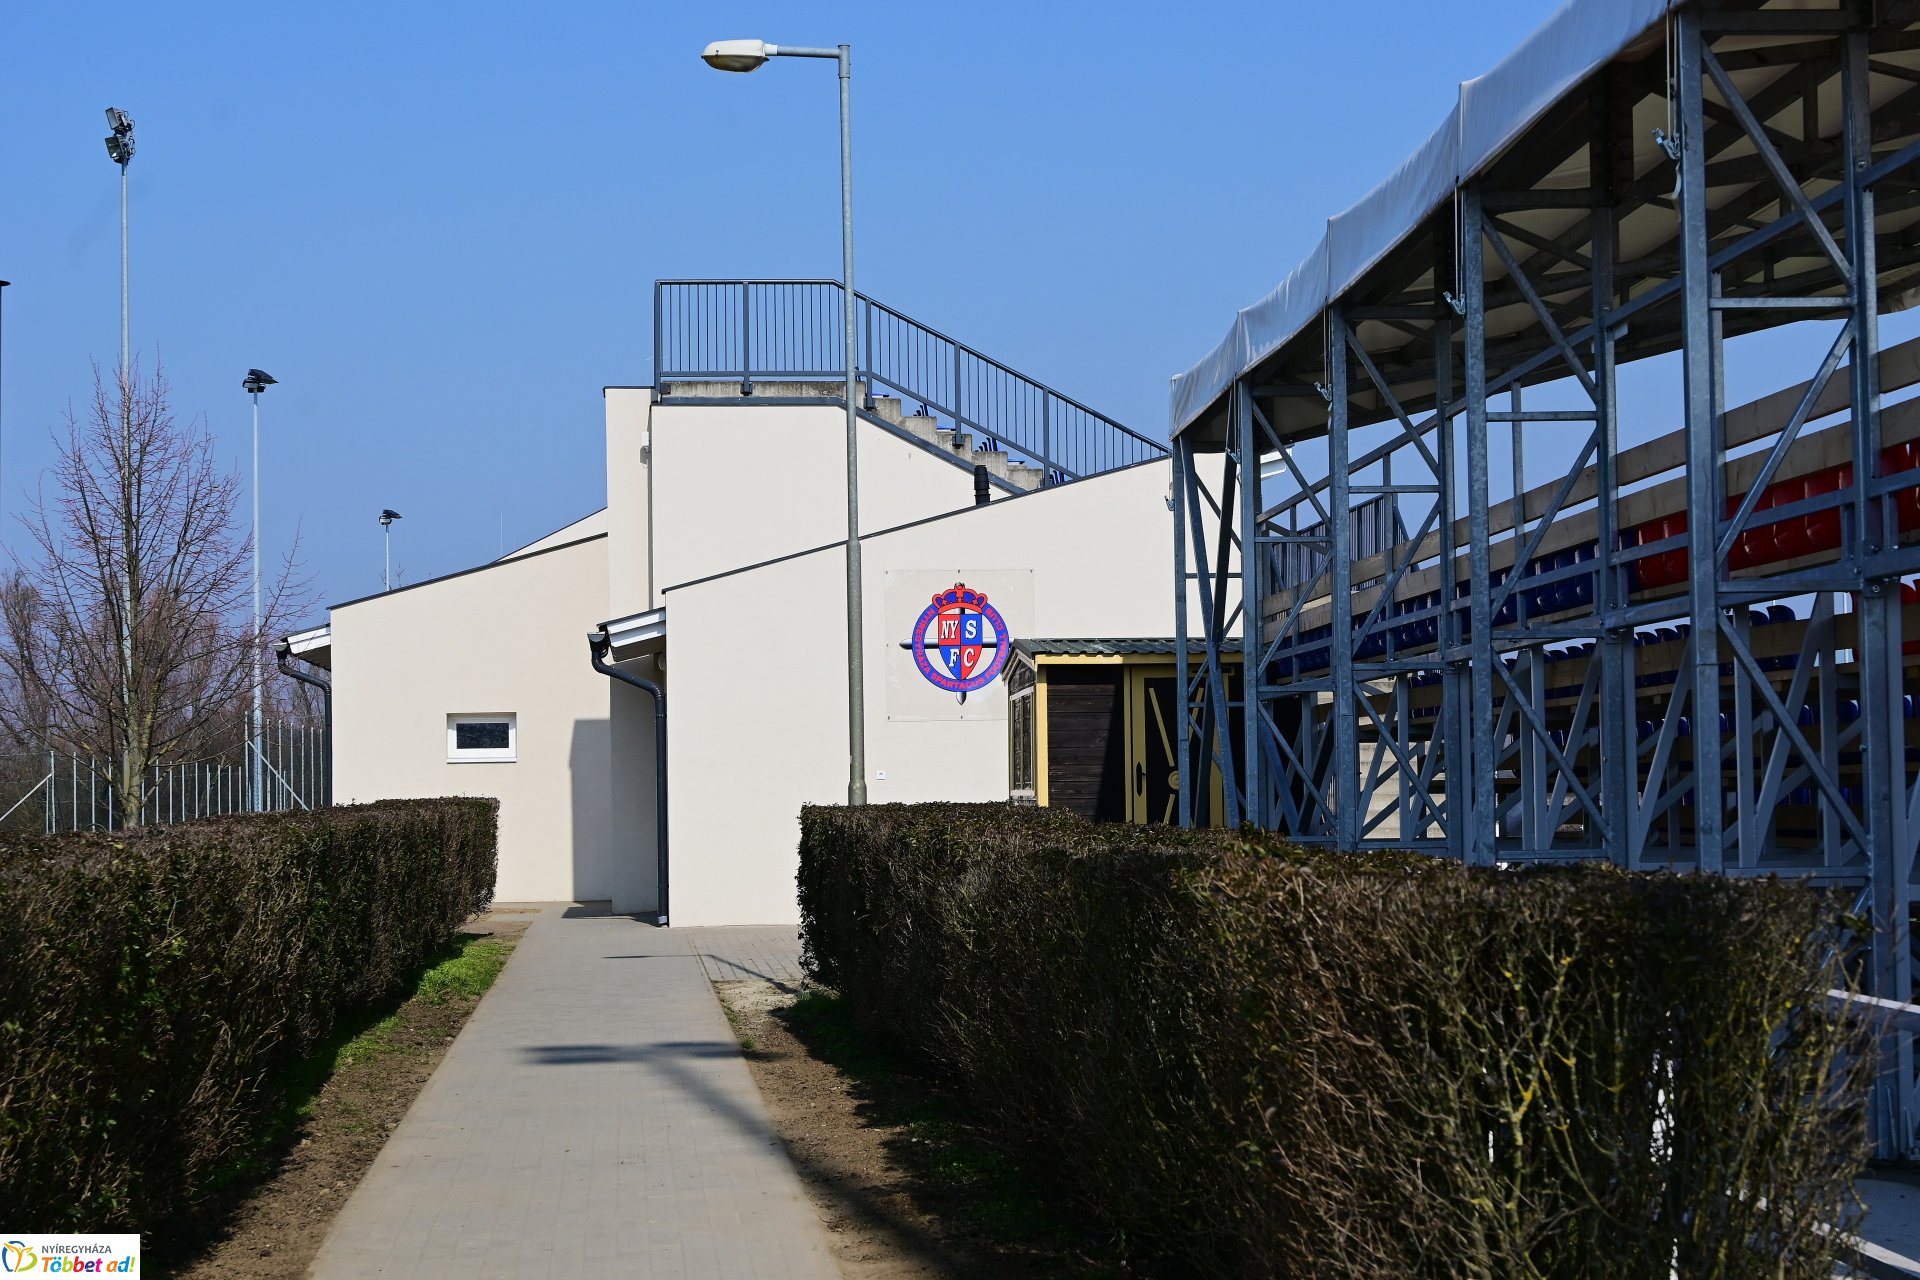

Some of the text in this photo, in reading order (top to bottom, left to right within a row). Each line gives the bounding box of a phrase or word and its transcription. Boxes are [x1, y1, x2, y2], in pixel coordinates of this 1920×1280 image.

[940, 619, 977, 639] NY S
[985, 607, 1004, 631] CLUB
[948, 647, 975, 667] F C
[985, 632, 1007, 680] FOOTBALL
[930, 673, 985, 689] SPARTACUS
